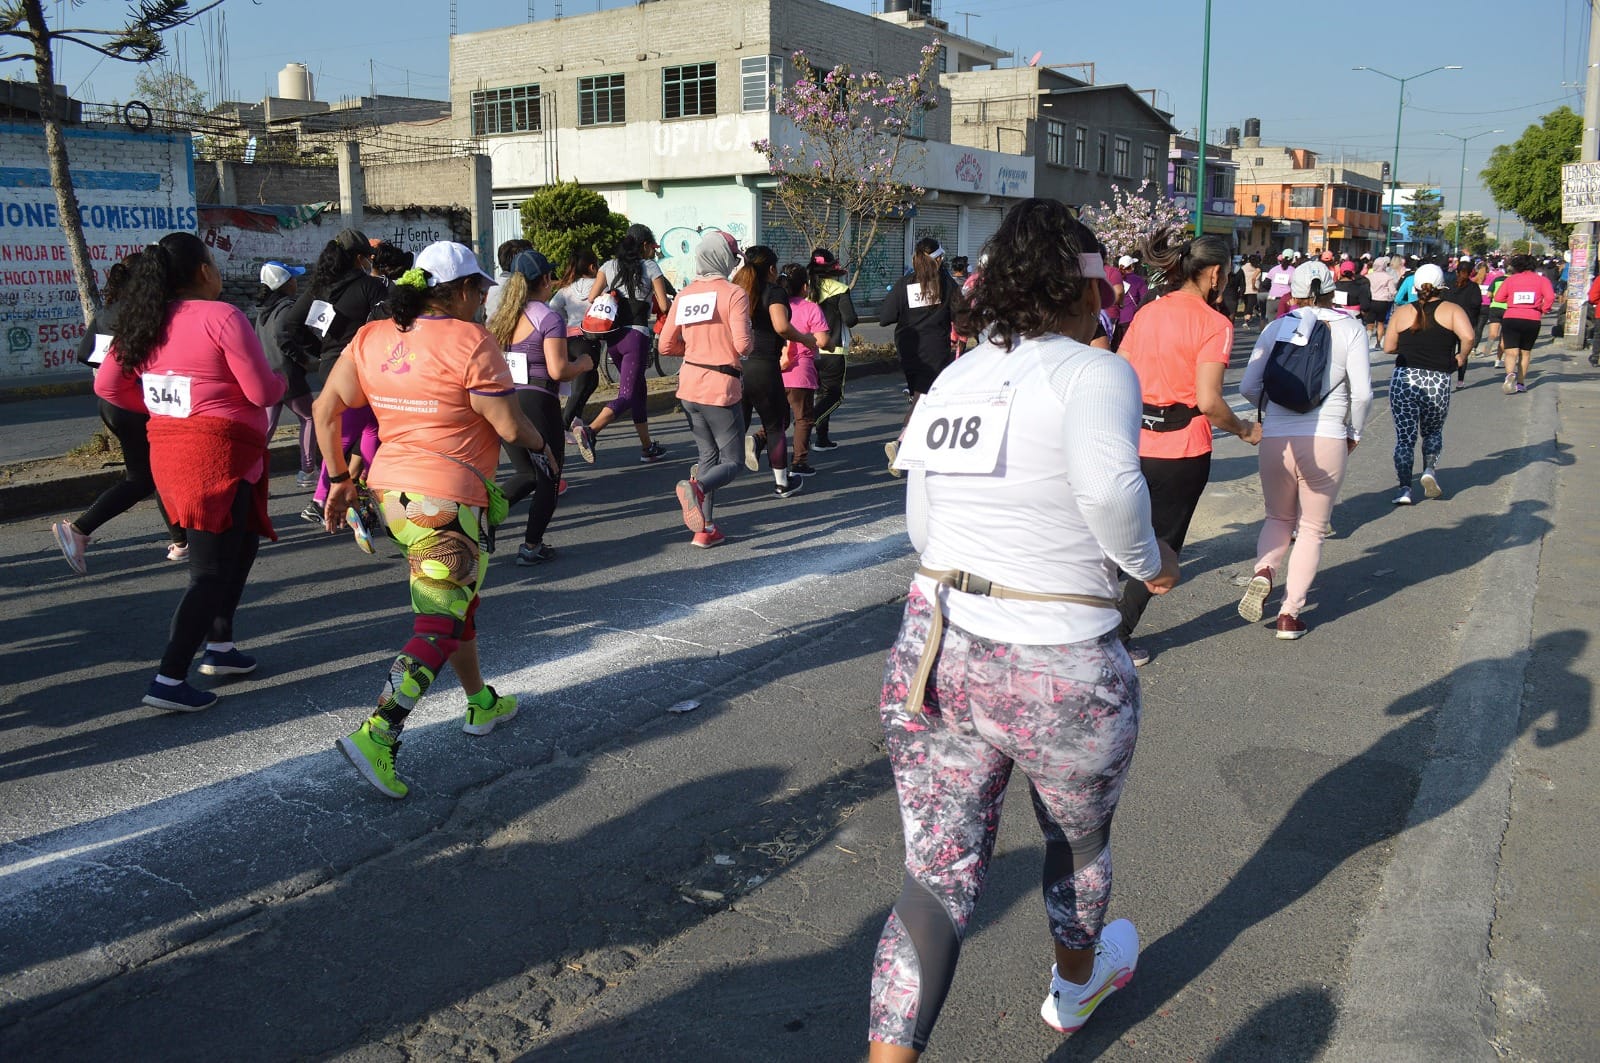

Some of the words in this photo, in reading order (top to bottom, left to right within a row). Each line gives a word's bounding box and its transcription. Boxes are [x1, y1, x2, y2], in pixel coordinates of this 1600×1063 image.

[654, 119, 752, 157] OPTICA
[79, 204, 197, 230] COMESTIBLES
[15, 245, 48, 260] HOJA
[51, 245, 66, 260] DE
[684, 303, 710, 317] 590
[149, 386, 182, 407] 344
[926, 416, 981, 450] 018
